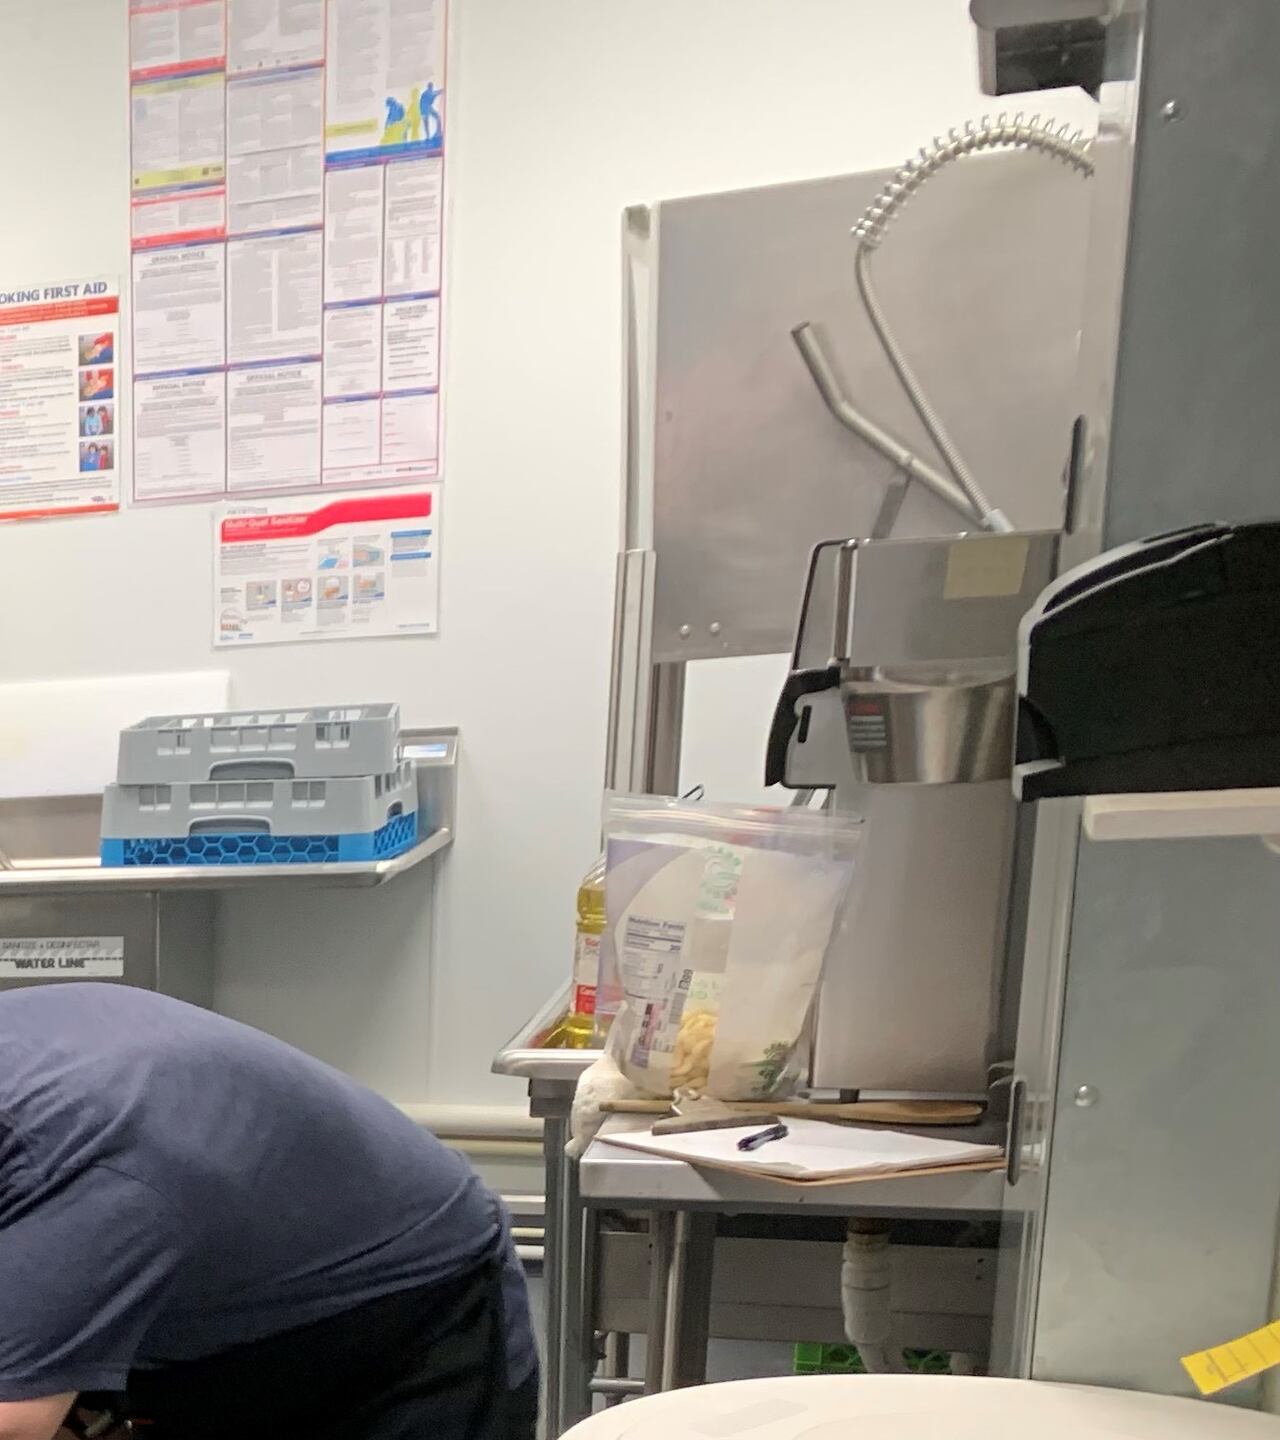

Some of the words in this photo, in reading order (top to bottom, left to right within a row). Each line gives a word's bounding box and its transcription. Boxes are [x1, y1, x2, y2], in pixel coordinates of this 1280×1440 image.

[43, 283, 81, 299] FIRST
[83, 281, 108, 295] AID
[14, 958, 56, 969] WATER
[58, 957, 86, 969] LINE
